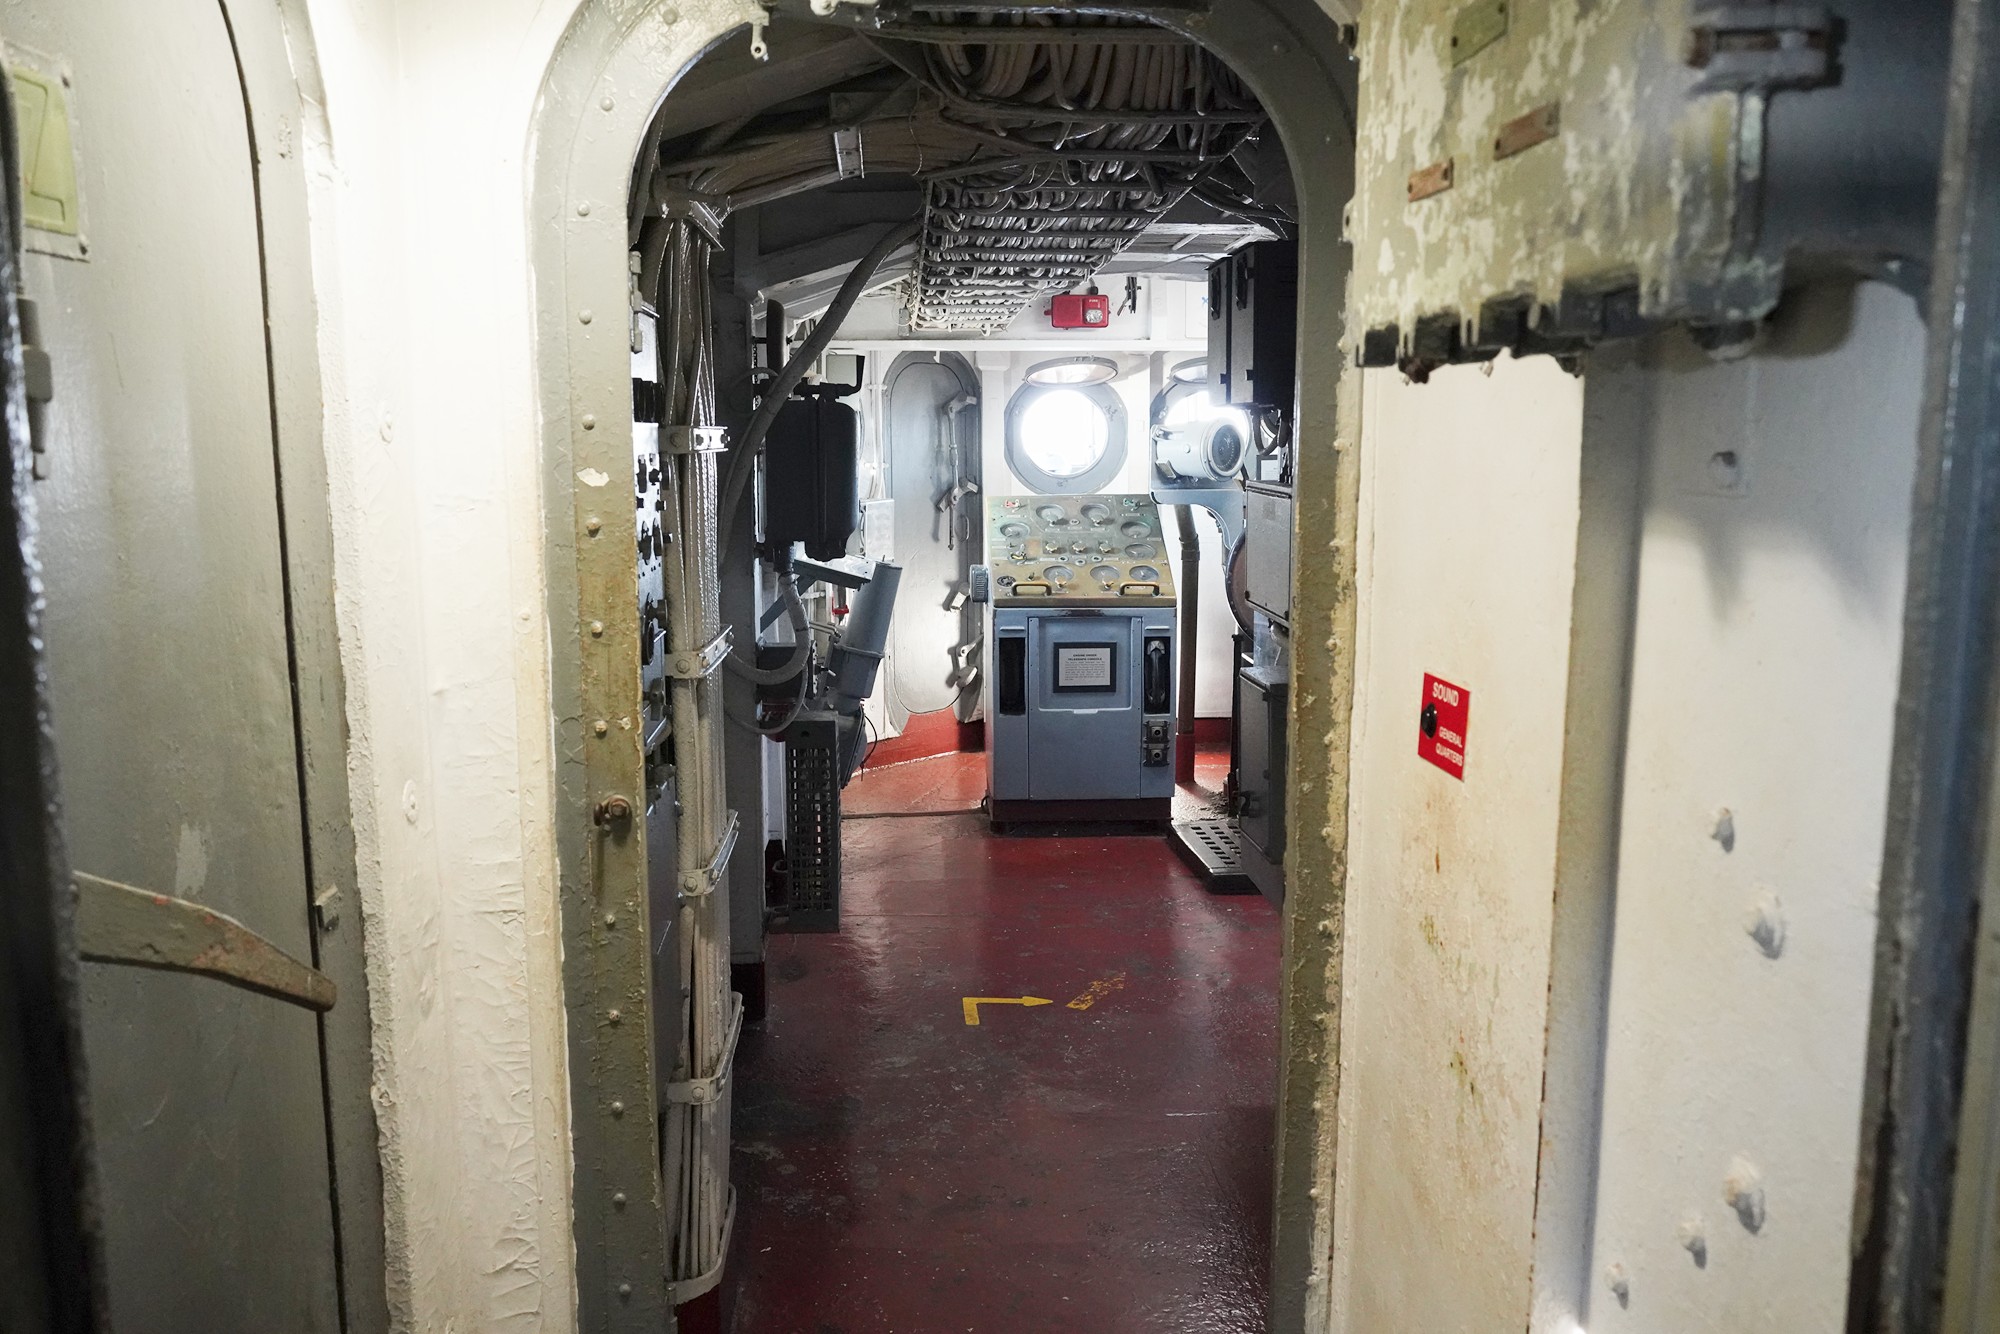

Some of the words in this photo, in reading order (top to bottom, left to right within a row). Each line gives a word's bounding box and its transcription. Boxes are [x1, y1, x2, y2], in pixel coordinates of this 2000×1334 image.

[1432, 681, 1459, 707] SOUND
[1439, 725, 1463, 748] GENERAL
[1435, 742, 1463, 767] QUARTERS
